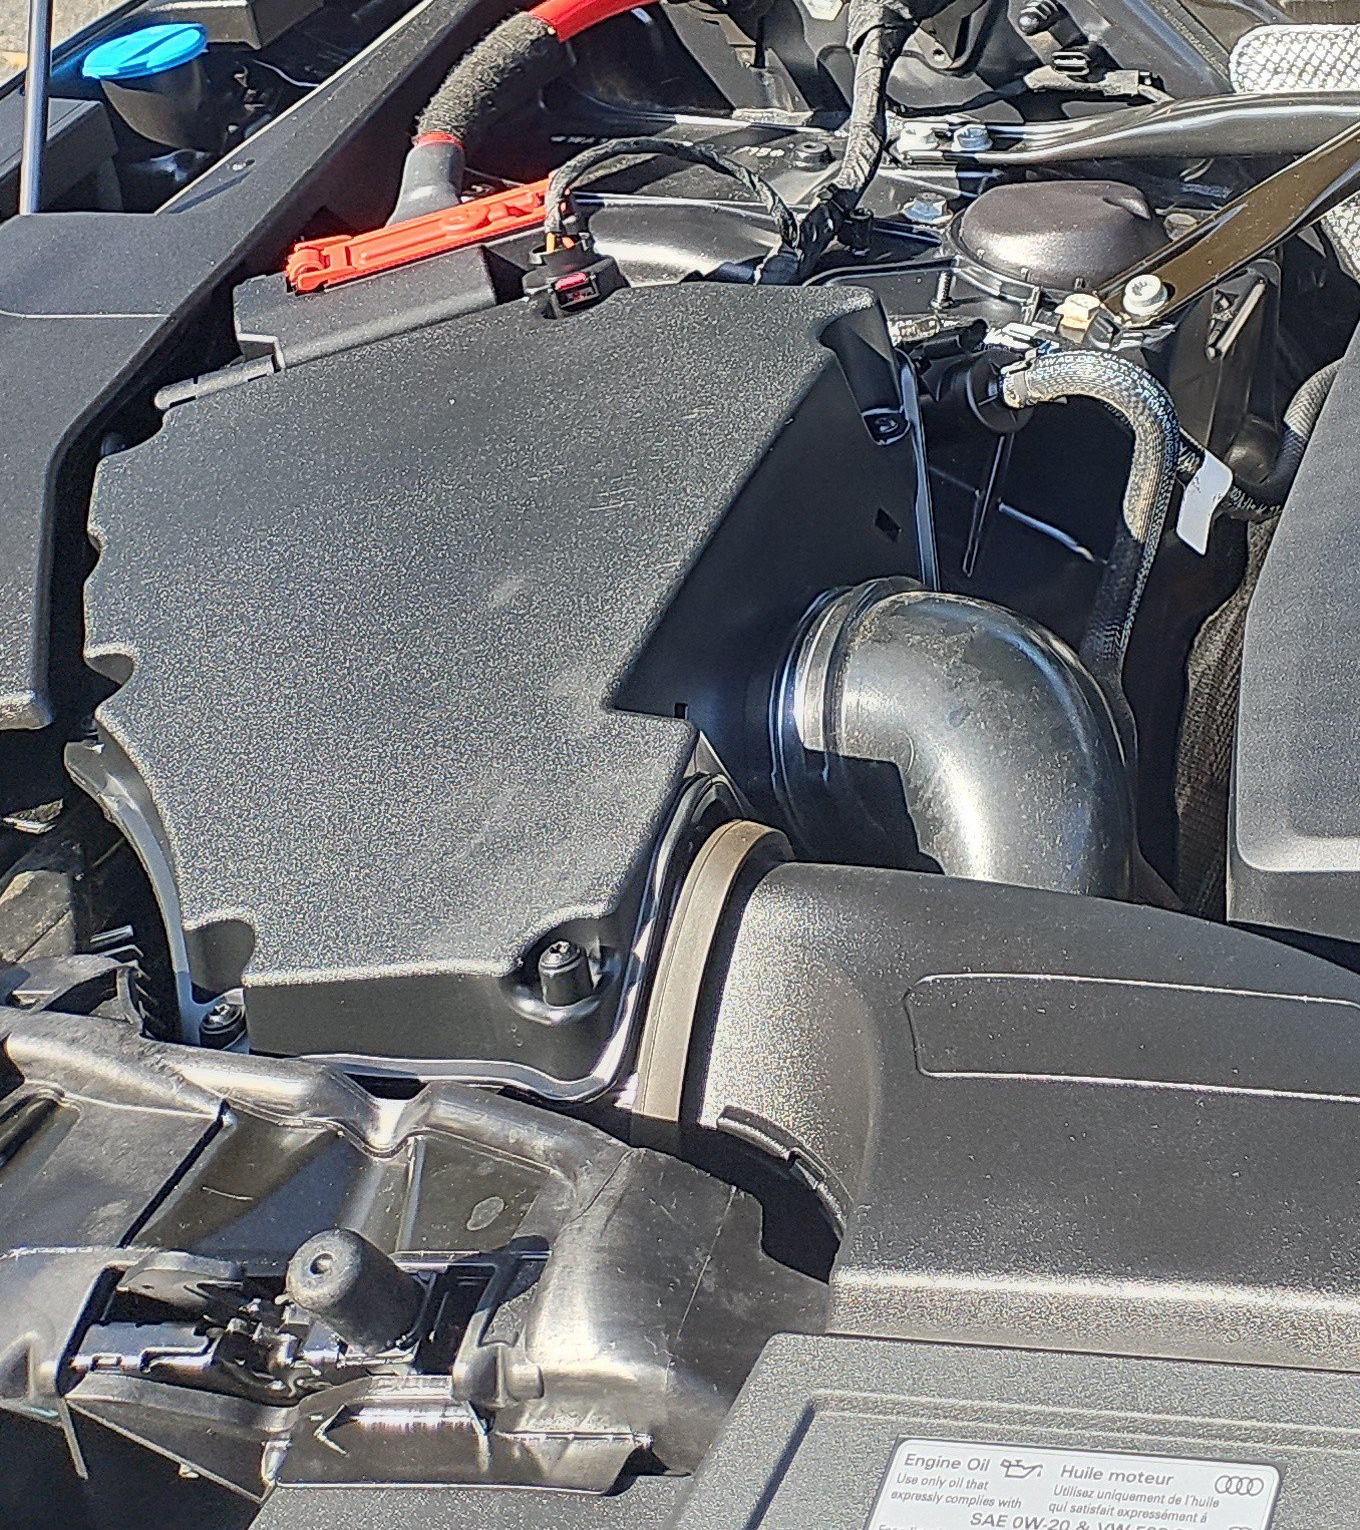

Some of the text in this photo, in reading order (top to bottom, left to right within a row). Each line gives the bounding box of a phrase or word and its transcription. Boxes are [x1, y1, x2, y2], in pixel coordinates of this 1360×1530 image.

[904, 1453, 990, 1472] Engine Oil
[896, 1472, 989, 1491] Use only oil that
[1060, 1464, 1174, 1485] Huile moteur
[891, 1490, 1022, 1509] expressly complies with
[1053, 1484, 1094, 1498] Utilisez
[1097, 1489, 1166, 1505] uniquement
[1168, 1492, 1182, 1506] de
[969, 1512, 1008, 1528] SAE
[1012, 1515, 1070, 1530] 0W-20
[1048, 1501, 1067, 1515] qui
[1069, 1503, 1114, 1517] satisfait
[1117, 1506, 1197, 1522] expressément
